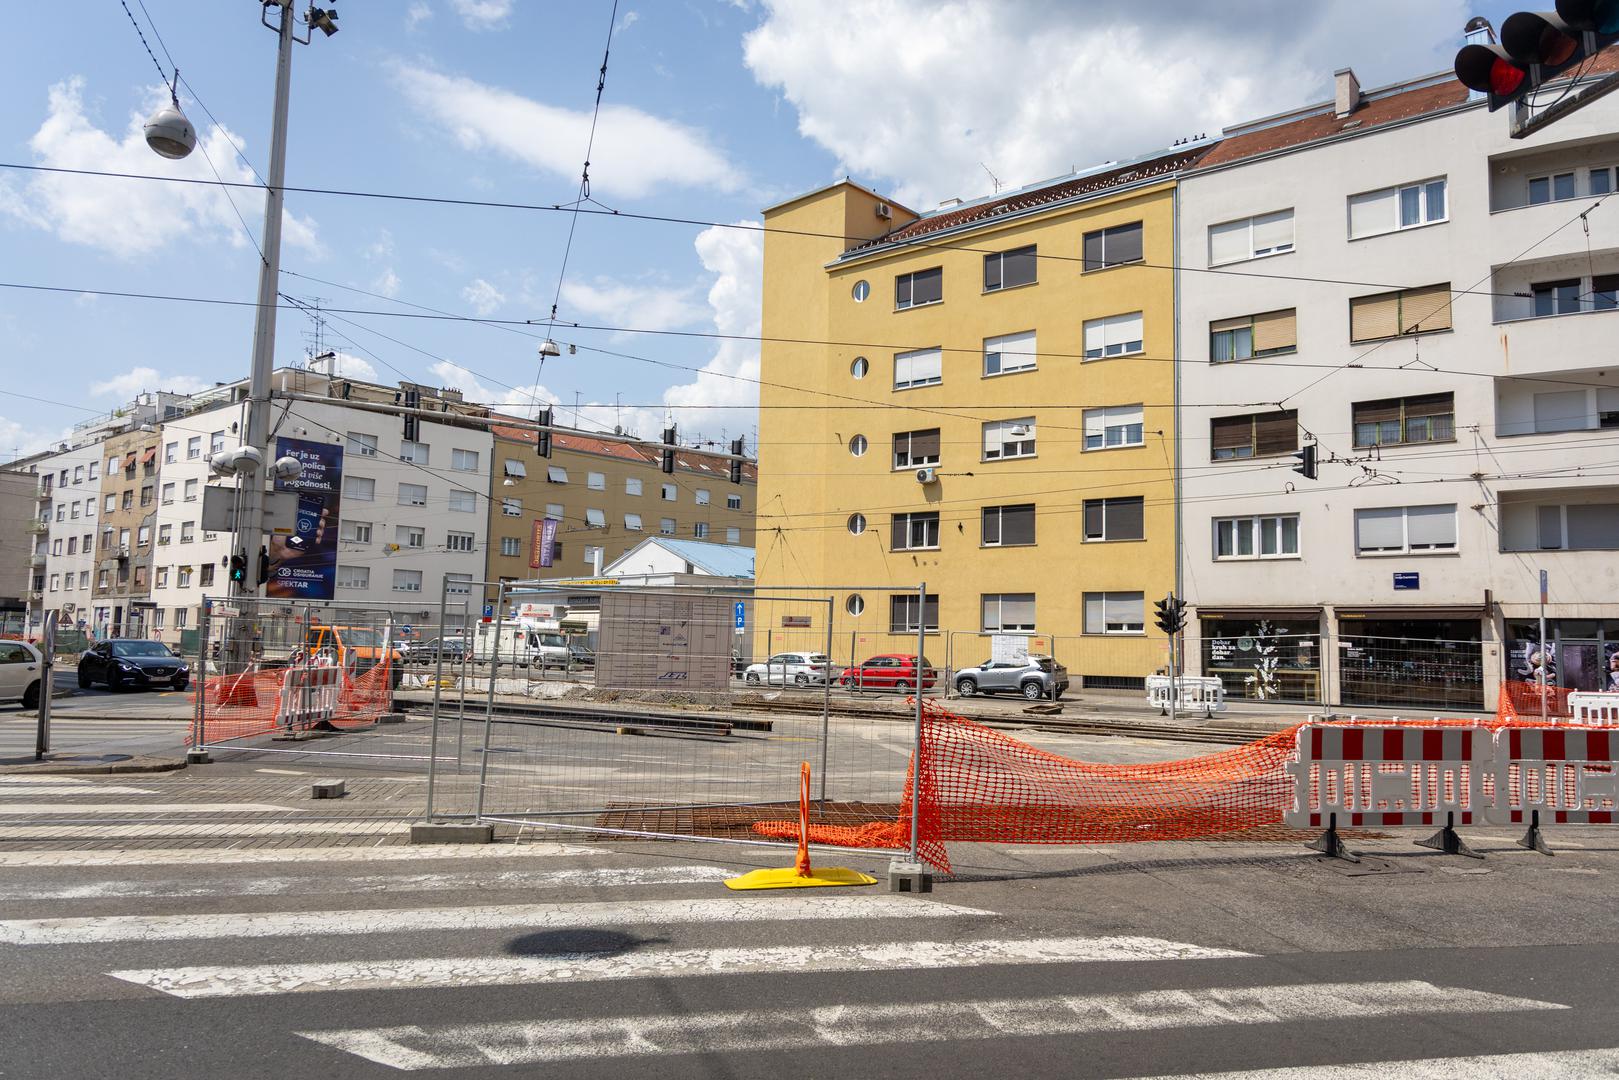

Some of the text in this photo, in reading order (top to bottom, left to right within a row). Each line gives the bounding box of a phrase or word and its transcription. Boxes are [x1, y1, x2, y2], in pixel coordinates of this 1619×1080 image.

[299, 450, 309, 460] je
[302, 461, 326, 471] polica
[277, 580, 309, 588] SPEKTAR
